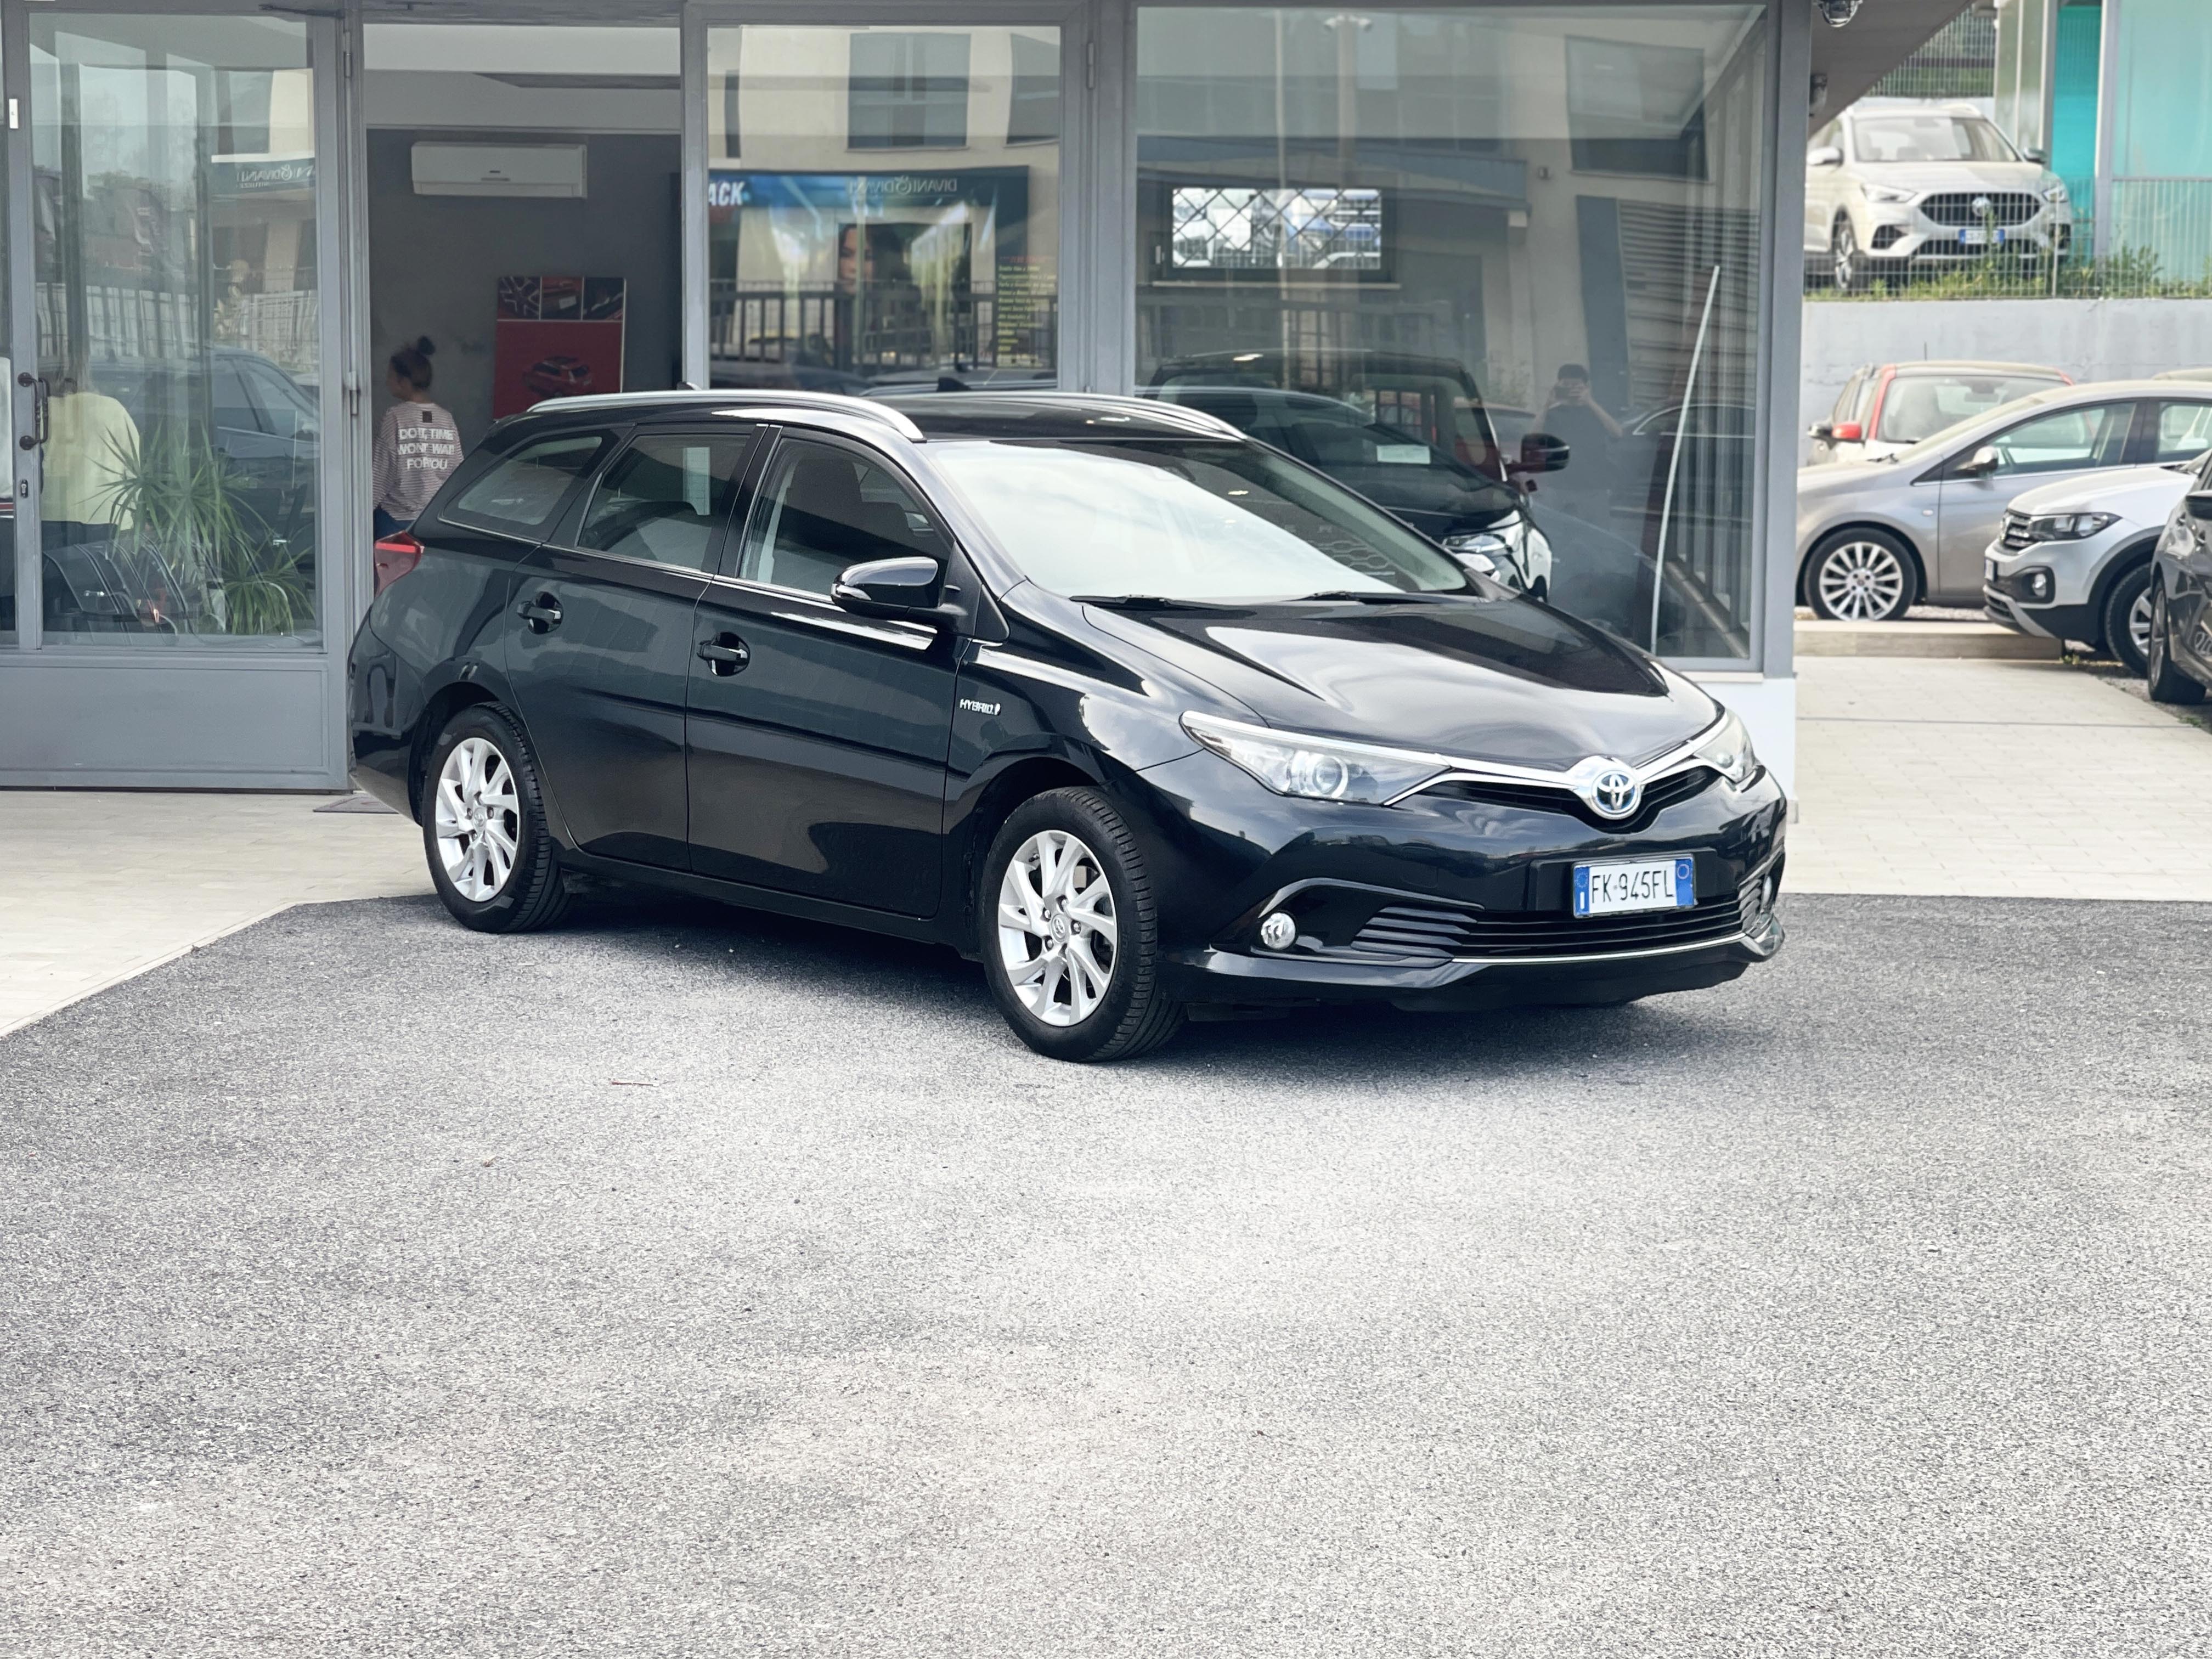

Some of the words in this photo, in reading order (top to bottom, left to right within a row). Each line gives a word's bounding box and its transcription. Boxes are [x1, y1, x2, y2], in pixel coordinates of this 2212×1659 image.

[399, 428, 417, 440] DO
[431, 459, 448, 470] OU
[960, 698, 994, 715] HYBRID
